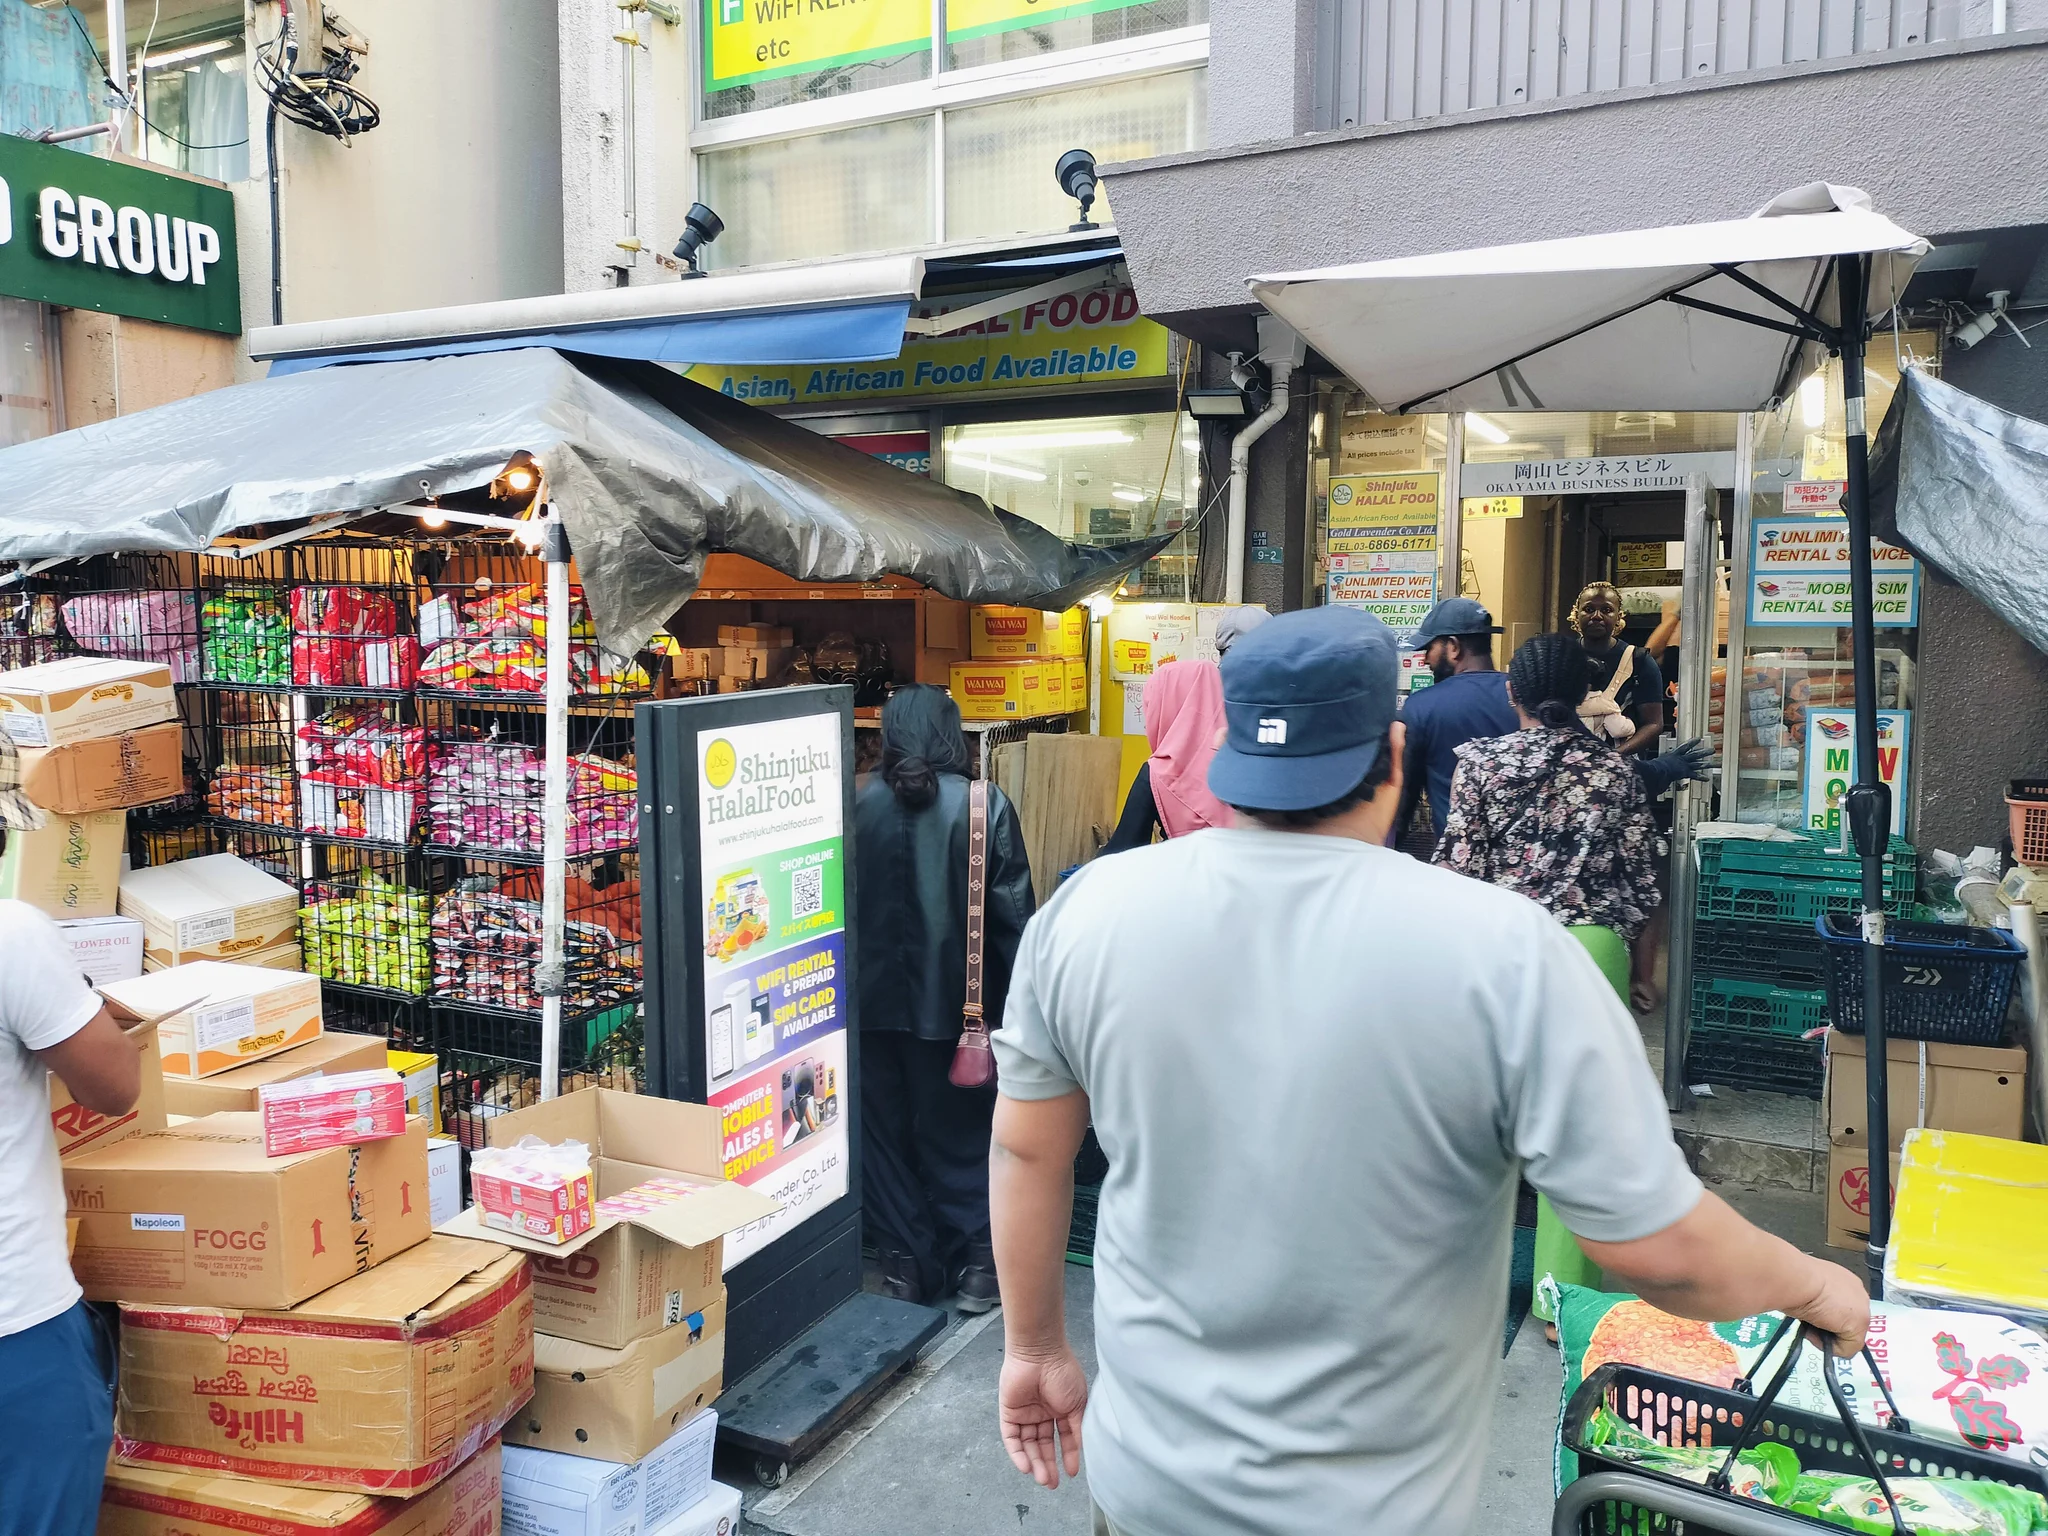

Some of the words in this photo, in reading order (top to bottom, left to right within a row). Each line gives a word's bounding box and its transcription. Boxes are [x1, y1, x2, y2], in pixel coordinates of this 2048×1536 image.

[756, 39, 790, 61] etc
[40, 186, 220, 285] GROUP
[1023, 289, 1140, 330] FOOD
[720, 375, 797, 401] Asian,
[805, 368, 905, 395] African
[914, 356, 986, 387] Food
[992, 344, 1137, 380] Available
[1357, 451, 1378, 459] prices
[1379, 449, 1403, 457] include
[1514, 458, 1673, 481] 岡山ビジネスビル
[1486, 481, 1556, 494] OKAYAMA
[1562, 478, 1629, 490] BUSINESS
[1633, 475, 1690, 487] BUILDI
[1793, 485, 1836, 495] 防犯カメラ
[1355, 495, 1396, 506] HALAL
[1400, 493, 1436, 504] FOOD
[1801, 494, 1828, 503] 作動中
[1380, 513, 1399, 522] Food
[1402, 513, 1436, 521] Available
[1330, 528, 1351, 538] Gold
[1354, 527, 1397, 537] Lavender
[1399, 526, 1414, 536] Co.
[1418, 525, 1435, 535] Ltd.
[1334, 538, 1431, 551] TEL.03-6869-6171
[1257, 550, 1277, 560] 9-2
[1765, 550, 1831, 562] RENTAL
[1837, 548, 1911, 561] SVICE
[1345, 577, 1406, 587] UNLIMITED
[1408, 577, 1432, 586] WiFi
[1807, 583, 1853, 595] MOBI
[1877, 582, 1907, 595] SIM
[1336, 590, 1379, 599] RENTAL
[1382, 589, 1432, 599] SERVICE
[1364, 605, 1408, 614] MOBILE
[1410, 604, 1430, 614] SIM
[1761, 601, 1827, 613] RENTAL
[1832, 601, 1907, 613] SEVICE
[987, 620, 1006, 629] WAI
[1007, 620, 1026, 629] WAI
[1382, 616, 1422, 626] SERVIC
[966, 680, 985, 689] WAI
[985, 679, 1004, 688] WAI
[740, 744, 831, 784] Shinjuku
[706, 776, 816, 825] HalalFood
[718, 815, 824, 846] www.shinjukuhalalfood.com
[779, 857, 804, 872] SHOP
[805, 848, 834, 865] ONLINE
[71, 938, 112, 950] LOWER
[114, 936, 132, 947] OIL
[756, 967, 786, 992] WIFI
[788, 950, 835, 980] RENTAL
[783, 983, 791, 997] &
[793, 967, 835, 993] PREPAID
[773, 1001, 797, 1026] SIM
[799, 987, 836, 1014] CARD
[782, 1005, 836, 1039] AVAILABLE
[722, 1087, 766, 1117] OMPUTER
[766, 1083, 772, 1095] &
[722, 1125, 761, 1162] ALES
[764, 1120, 774, 1140] &
[724, 1138, 775, 1181] ERVICE
[432, 1164, 449, 1177] OIL
[802, 1169, 819, 1184] Co.
[821, 1153, 839, 1173] Ltd.
[134, 1217, 181, 1229] Napoleon
[526, 1217, 551, 1233] RED
[193, 1229, 267, 1251] FOGG
[561, 1297, 575, 1307] Paste
[208, 1402, 304, 1451] Hilife
[610, 1476, 620, 1486] BR
[620, 1463, 643, 1481] GROUP
